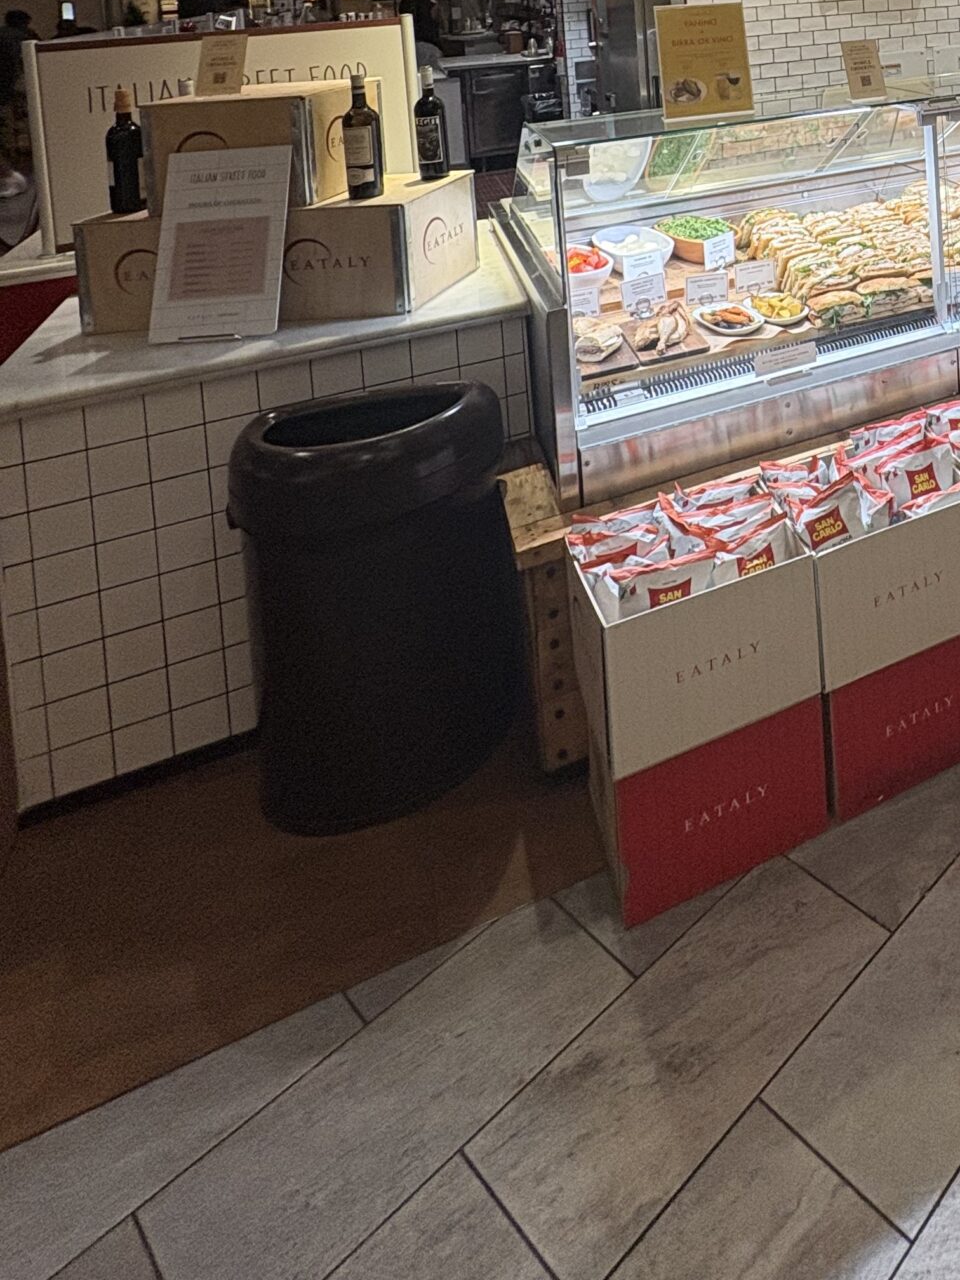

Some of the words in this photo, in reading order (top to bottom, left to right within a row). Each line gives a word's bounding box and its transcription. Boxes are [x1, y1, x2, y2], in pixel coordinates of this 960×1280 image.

[427, 221, 466, 252] EATALY
[290, 255, 372, 272] EATALY
[911, 478, 936, 494] CARLO
[914, 472, 930, 484] SAN
[812, 521, 843, 542] CARLO
[814, 517, 836, 531] SAN
[659, 589, 682, 603] SAN
[873, 569, 944, 608] EATALY
[675, 640, 760, 684] EATALY
[886, 694, 955, 738] EATALY
[684, 784, 767, 833] EATALY
